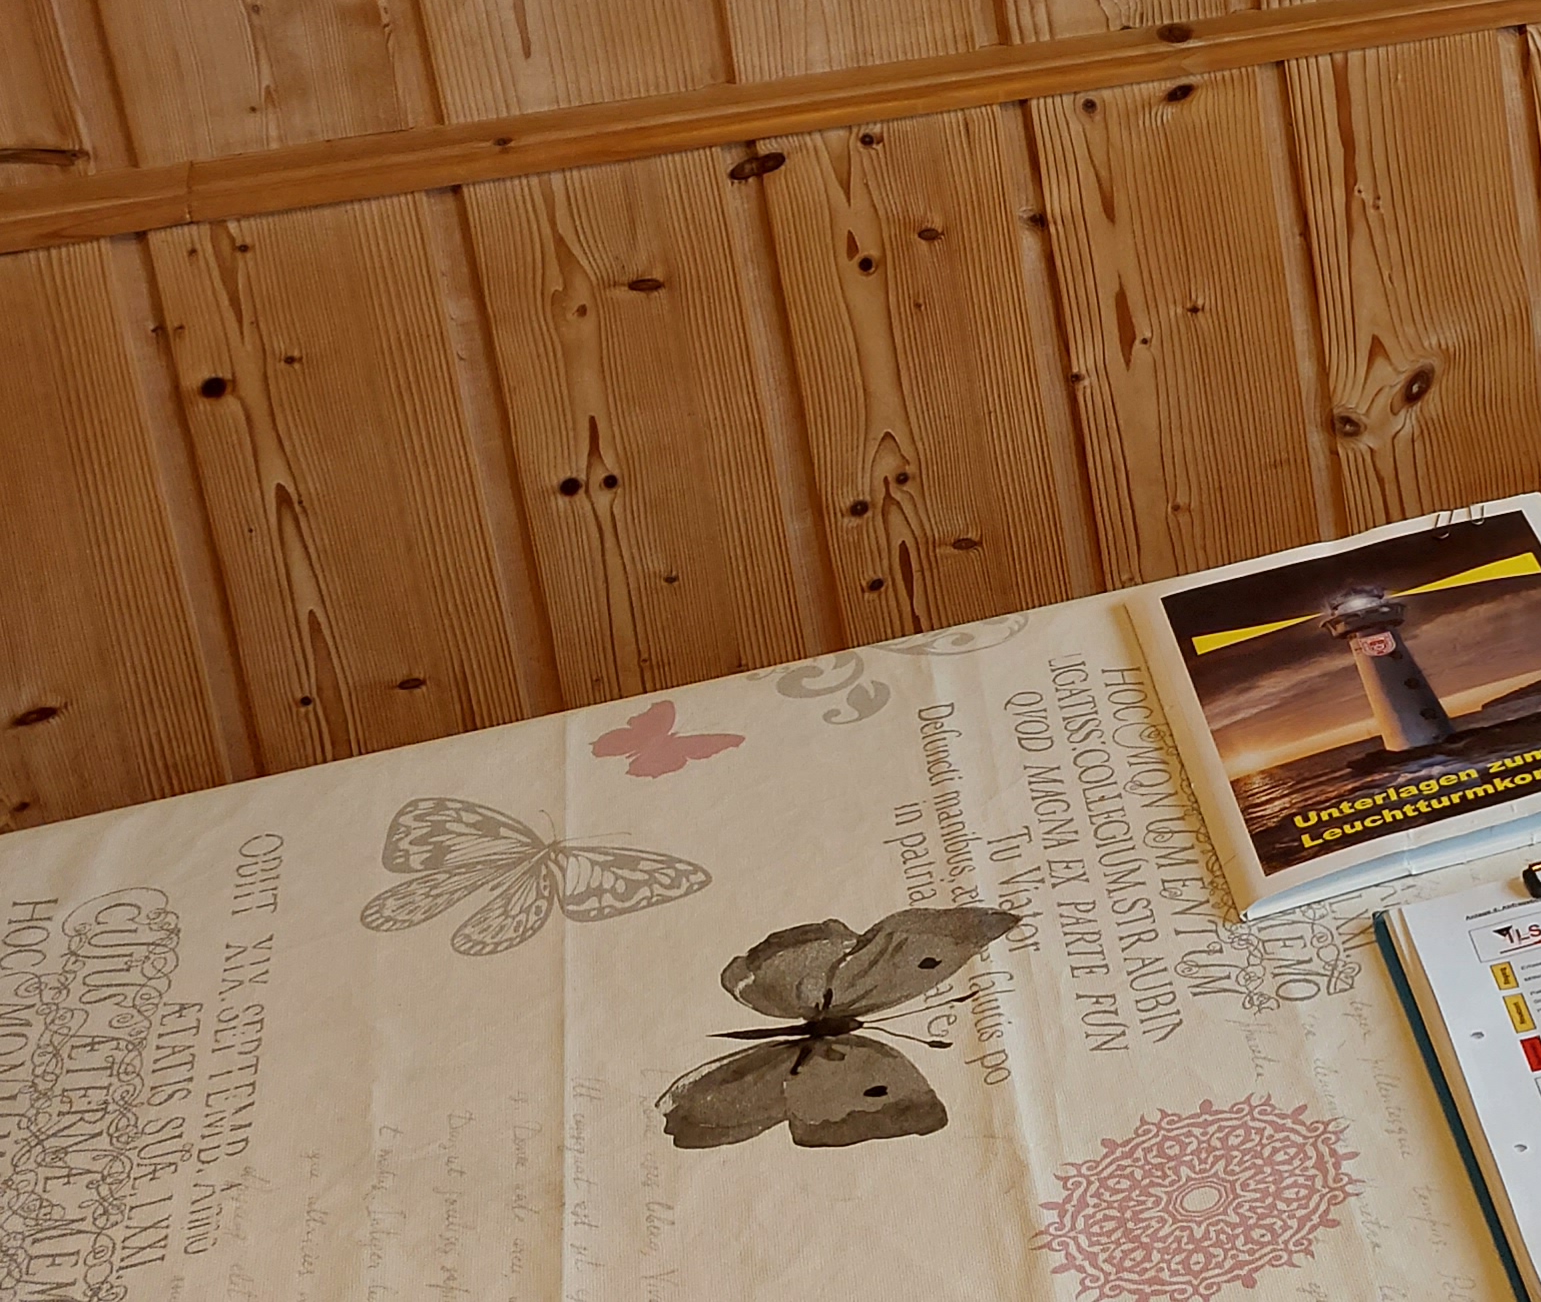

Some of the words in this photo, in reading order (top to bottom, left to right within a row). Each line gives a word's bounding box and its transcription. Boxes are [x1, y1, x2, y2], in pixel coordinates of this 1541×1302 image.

[890, 799, 928, 827] in
[1021, 756, 1081, 852] MAGNA
[1293, 766, 1479, 829] Unterlagen
[983, 823, 1037, 865] Tu
[1044, 851, 1090, 891] EX
[1054, 892, 1112, 981] PARTE
[1073, 983, 1132, 1059] FUN
